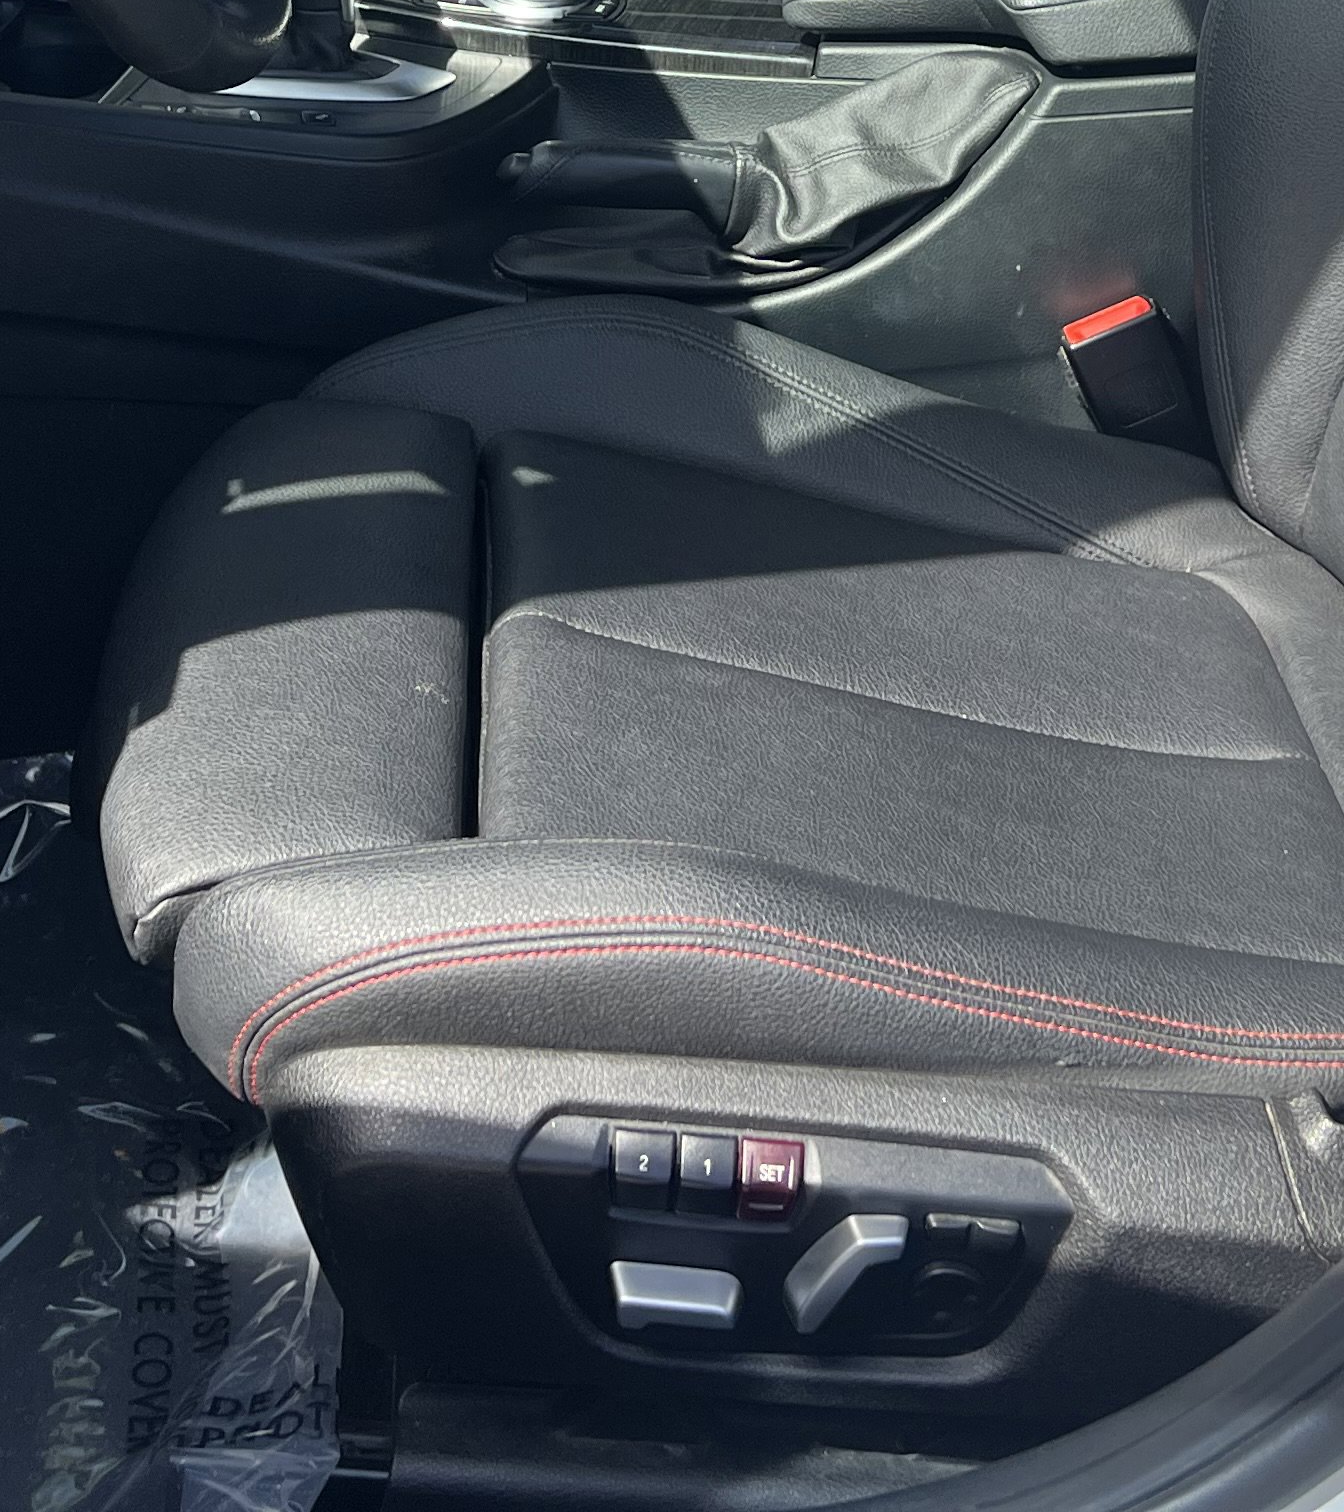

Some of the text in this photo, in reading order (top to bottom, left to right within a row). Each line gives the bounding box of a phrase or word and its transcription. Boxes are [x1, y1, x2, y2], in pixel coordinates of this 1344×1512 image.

[639, 1154, 649, 1172] 2
[704, 1158, 711, 1176] 1
[759, 1164, 785, 1183] SET
